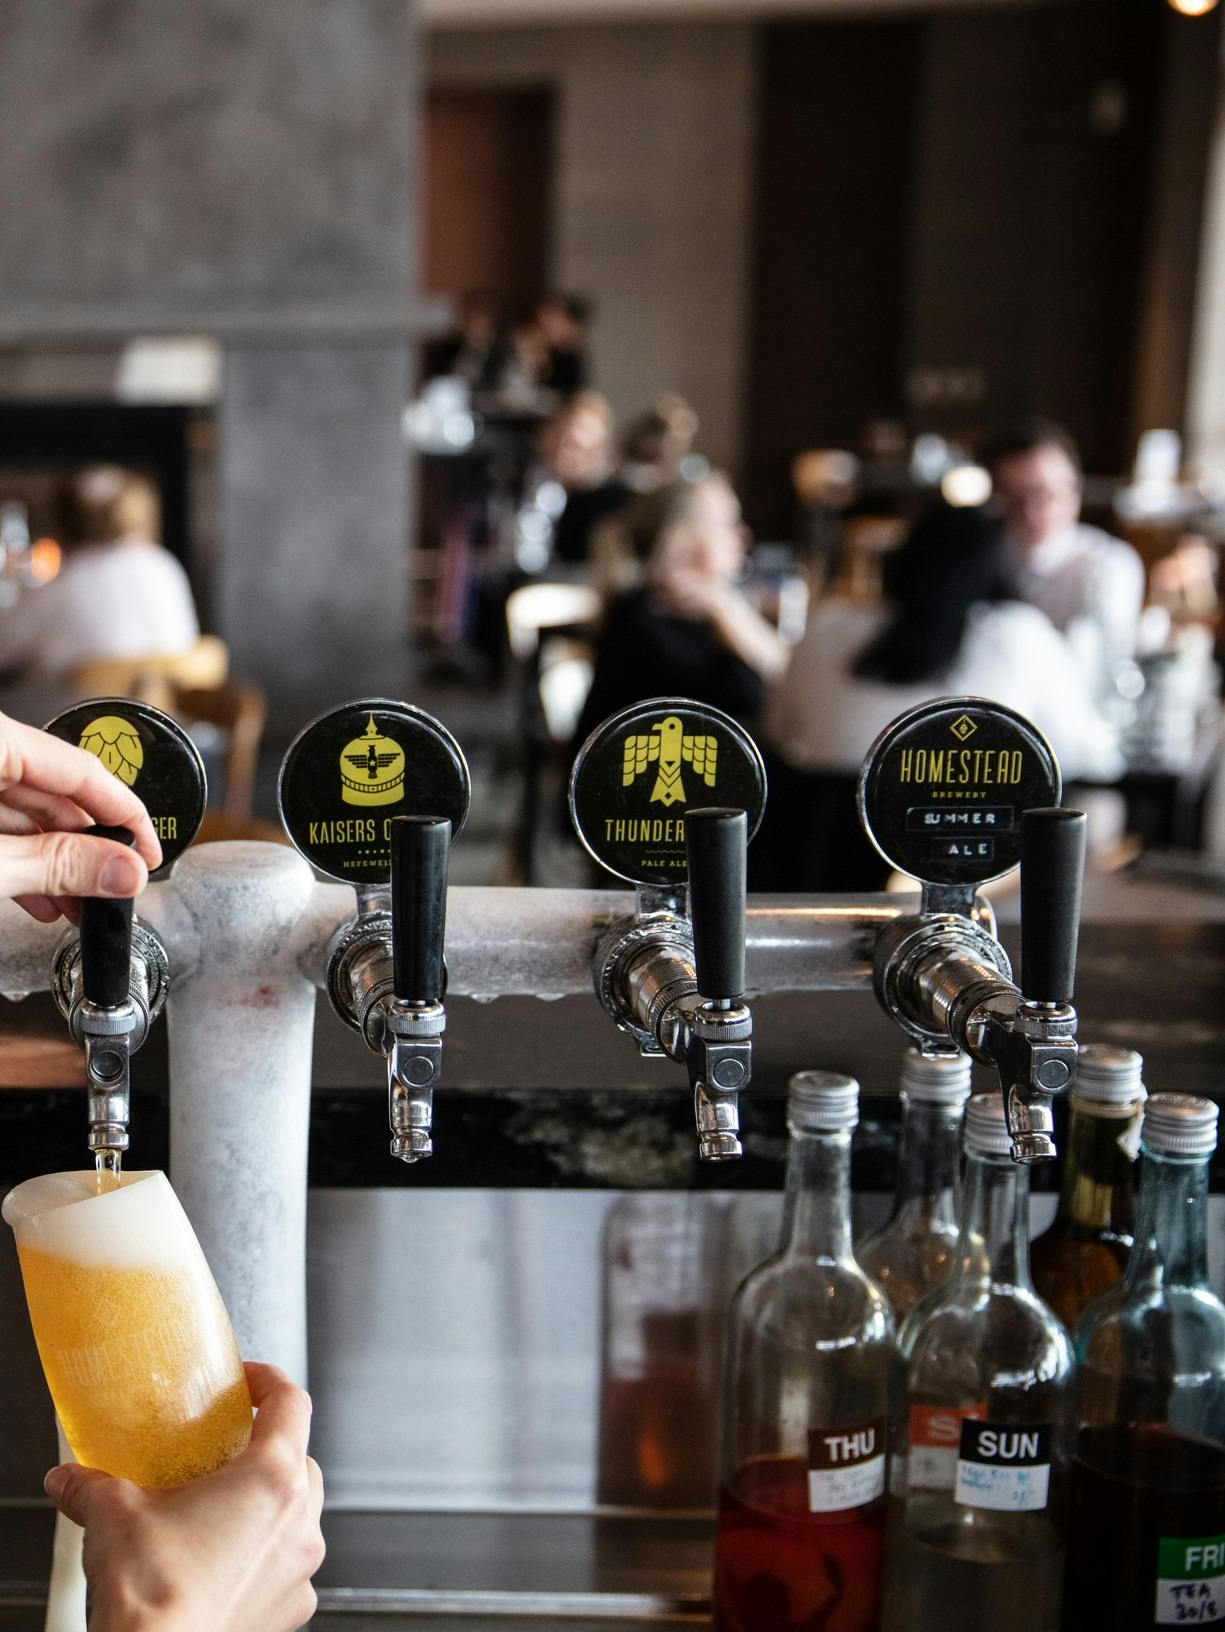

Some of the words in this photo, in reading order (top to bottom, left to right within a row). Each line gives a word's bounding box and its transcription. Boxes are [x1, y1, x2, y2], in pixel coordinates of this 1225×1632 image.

[900, 749, 1024, 784] HOMESTEAD
[932, 791, 988, 799] BREWERY
[924, 812, 996, 824] SUMMER
[309, 818, 376, 845] KAISERS
[604, 819, 685, 842] THUNDER
[947, 843, 988, 856] ALE
[343, 859, 392, 868] HEFEWEI
[823, 1427, 875, 1463] THU
[977, 1430, 1039, 1459] SUN
[1184, 1542, 1225, 1572] FRI
[1169, 1582, 1211, 1600] TEA
